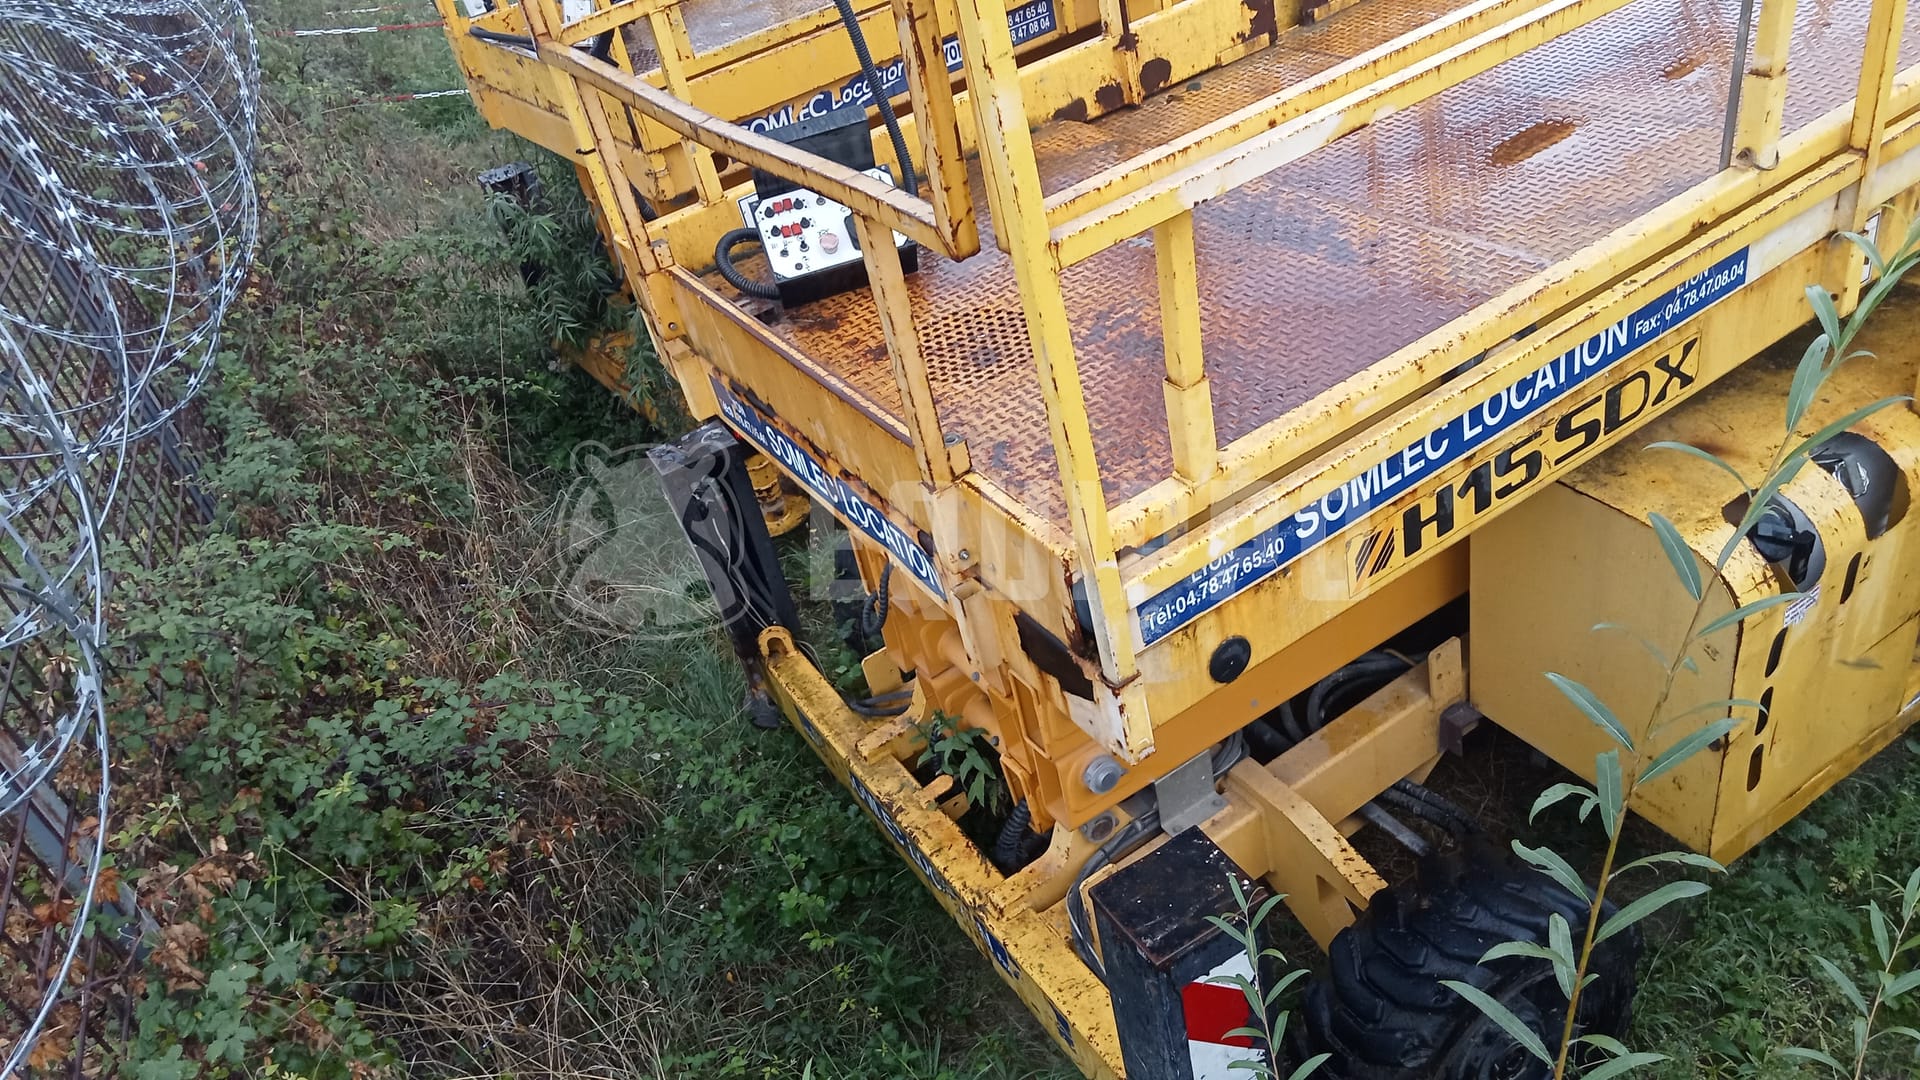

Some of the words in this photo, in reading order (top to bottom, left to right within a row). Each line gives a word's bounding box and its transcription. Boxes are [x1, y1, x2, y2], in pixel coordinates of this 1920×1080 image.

[1015, 10, 1023, 23] 47
[1025, 6, 1036, 19] 65
[1037, 1, 1047, 14] 40
[1018, 25, 1027, 38] 47
[1029, 21, 1039, 34] 08
[1040, 16, 1050, 30] 04
[1635, 313, 1662, 339] Fax:
[1665, 259, 1745, 321] 04.78.47.08.04
[1295, 424, 1449, 538] SOMLEC
[1463, 316, 1630, 441] LOCATION
[765, 425, 838, 502] SOMLEC
[839, 484, 944, 593] LOCATION
